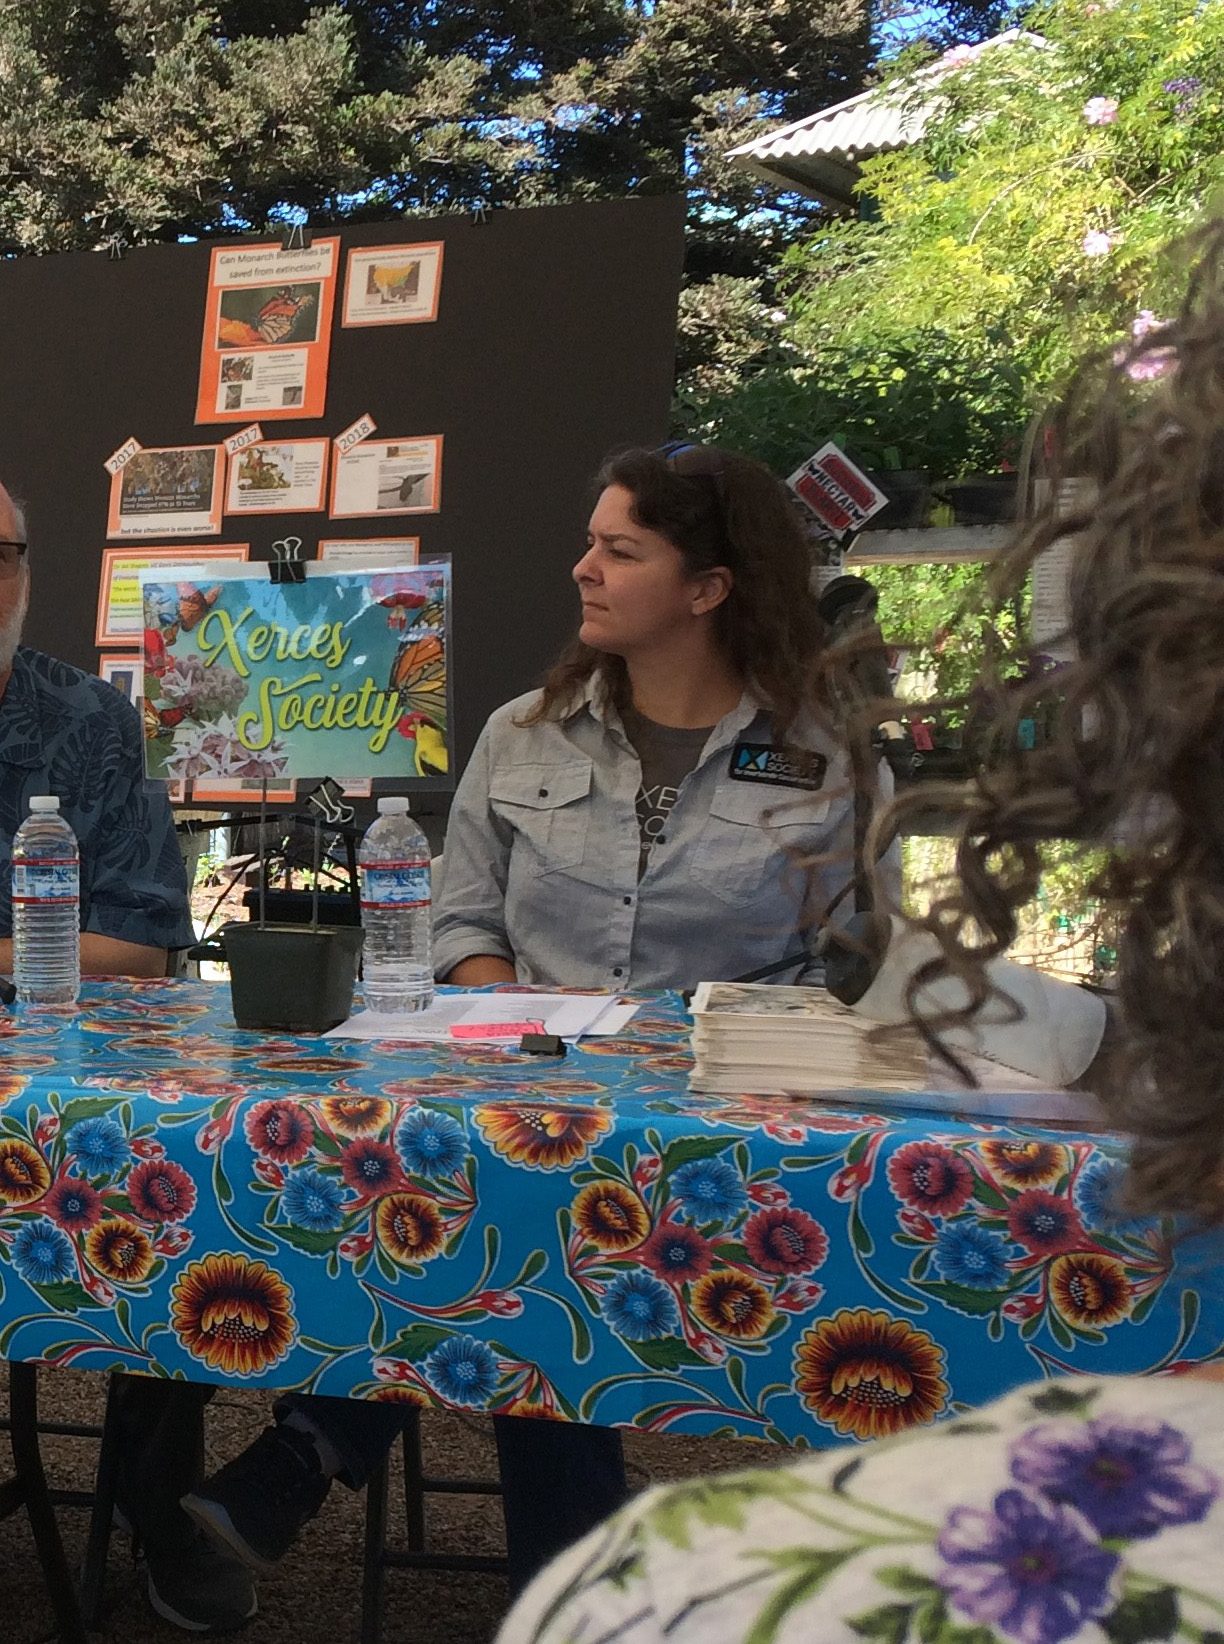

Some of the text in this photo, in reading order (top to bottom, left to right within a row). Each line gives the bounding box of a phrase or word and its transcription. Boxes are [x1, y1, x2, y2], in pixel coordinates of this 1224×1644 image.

[220, 247, 331, 264] Can Monarch Butterflies be
[229, 262, 322, 279] saved from extinction?
[229, 427, 258, 451] 2017
[339, 422, 370, 450] 2018
[111, 441, 136, 471] 2017
[816, 472, 857, 514] NECTAR
[197, 607, 351, 678] Xerces
[237, 673, 402, 752] Society
